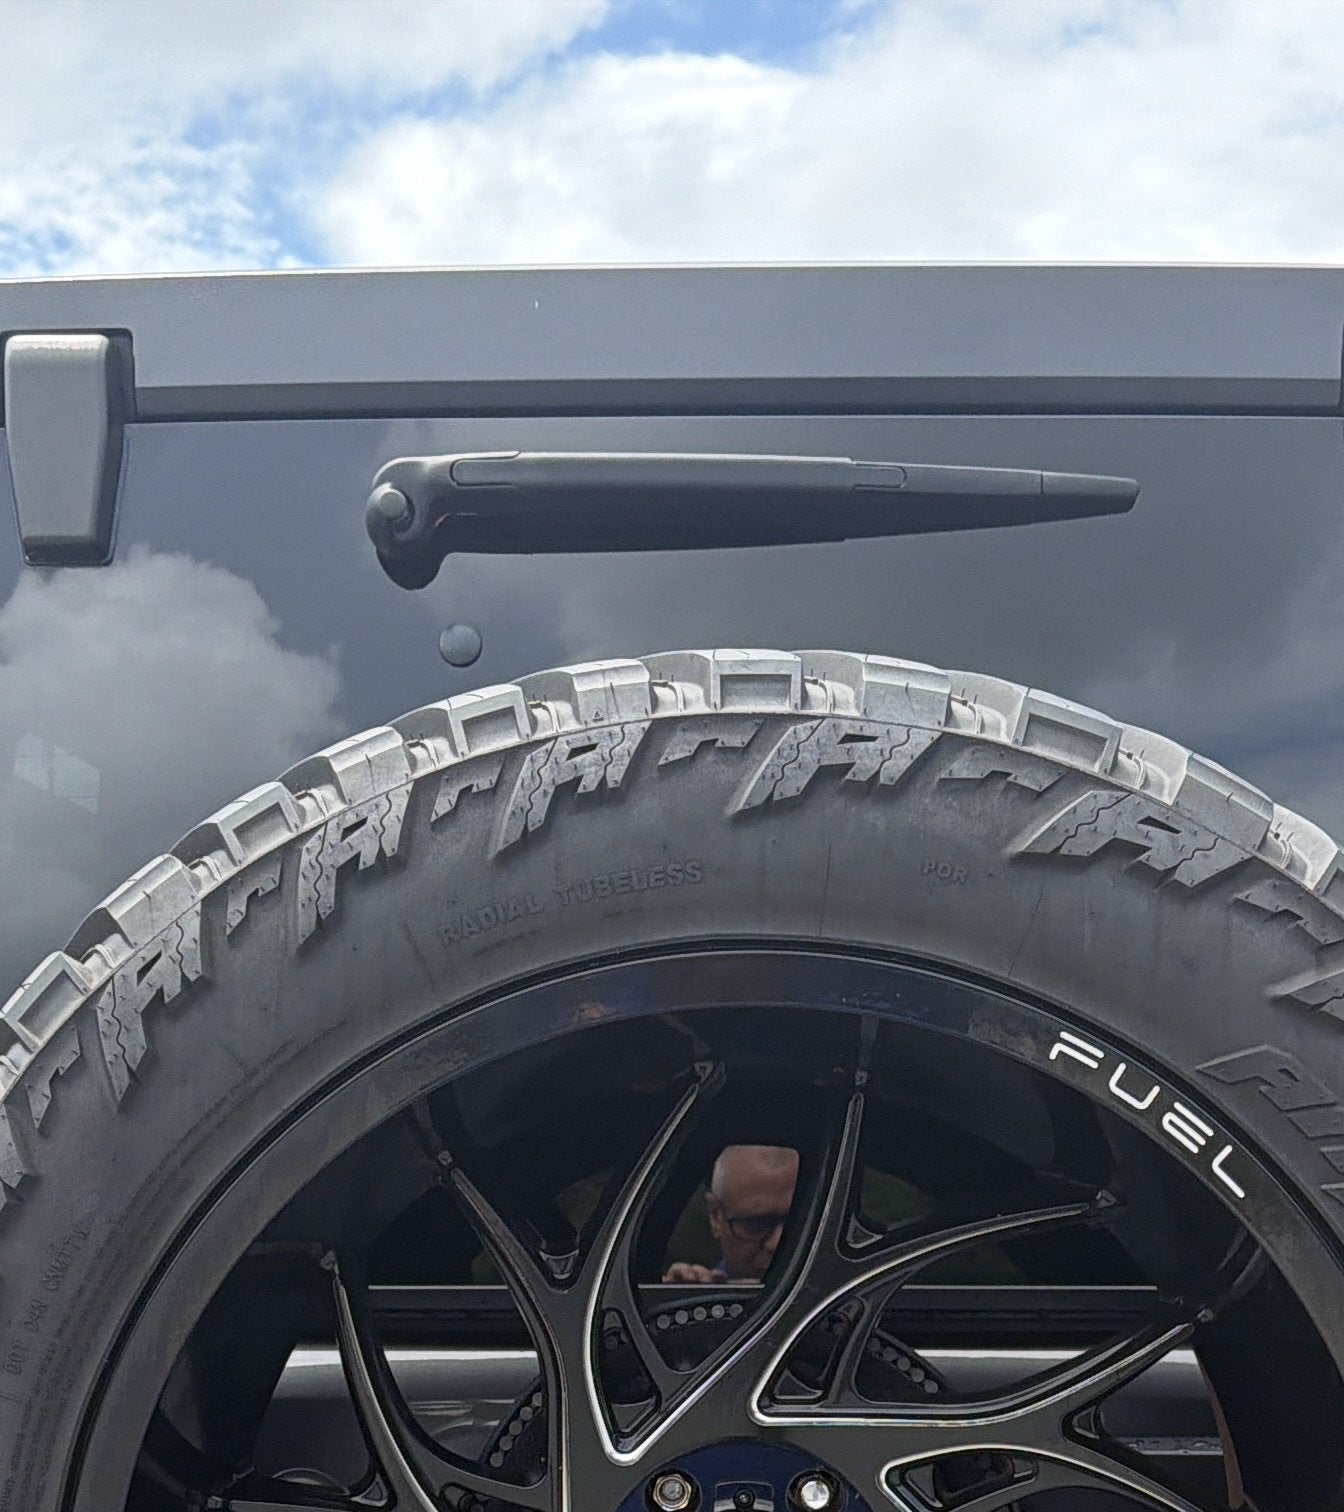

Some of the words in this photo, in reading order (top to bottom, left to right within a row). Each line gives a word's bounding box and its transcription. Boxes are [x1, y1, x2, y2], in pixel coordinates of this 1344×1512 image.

[435, 889, 546, 949] RADIAL
[553, 859, 705, 909] TUBELESS
[1048, 1031, 1246, 1199] FUEL
